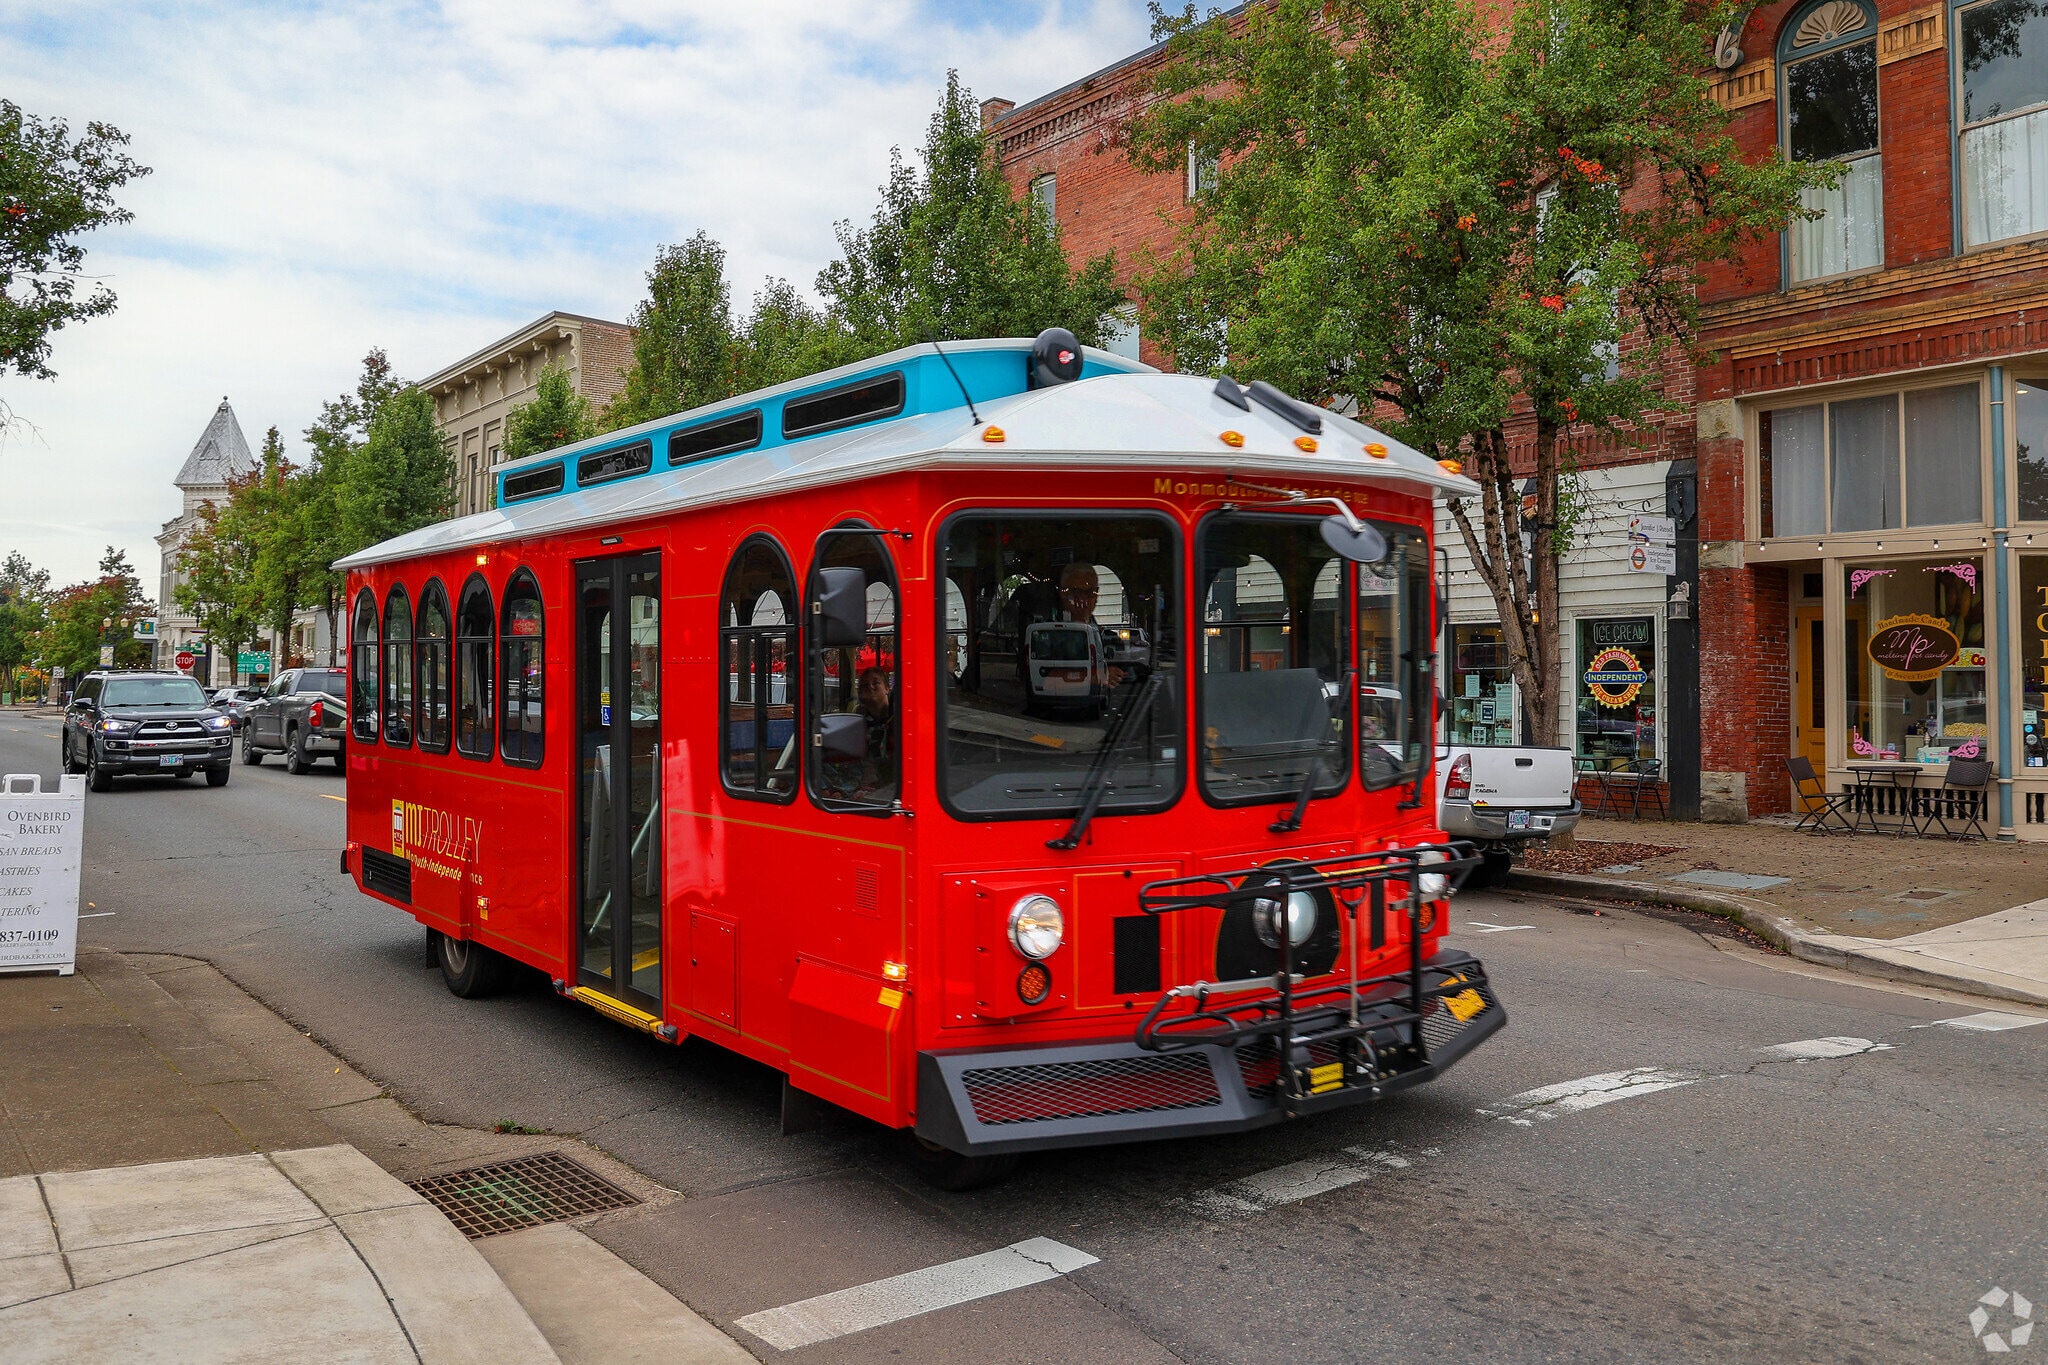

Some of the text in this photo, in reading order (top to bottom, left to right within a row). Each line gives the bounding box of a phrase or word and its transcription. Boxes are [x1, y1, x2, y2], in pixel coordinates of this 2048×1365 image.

[1877, 615, 1947, 629] Handmade Candy
[1596, 624, 1647, 641] ICE CREAM
[176, 656, 195, 665] STOP
[1595, 652, 1635, 670] OLD FASHIONED
[1588, 673, 1643, 682] INDEPENDENT
[1601, 693, 1624, 704] CREAM
[1623, 684, 1637, 702] SHOP
[7, 810, 72, 822] OVENBIRD
[19, 823, 64, 835] BAKERY
[20, 846, 63, 856] BREADS
[0, 886, 33, 897] CAKES
[0, 929, 59, 943] 837-0109
